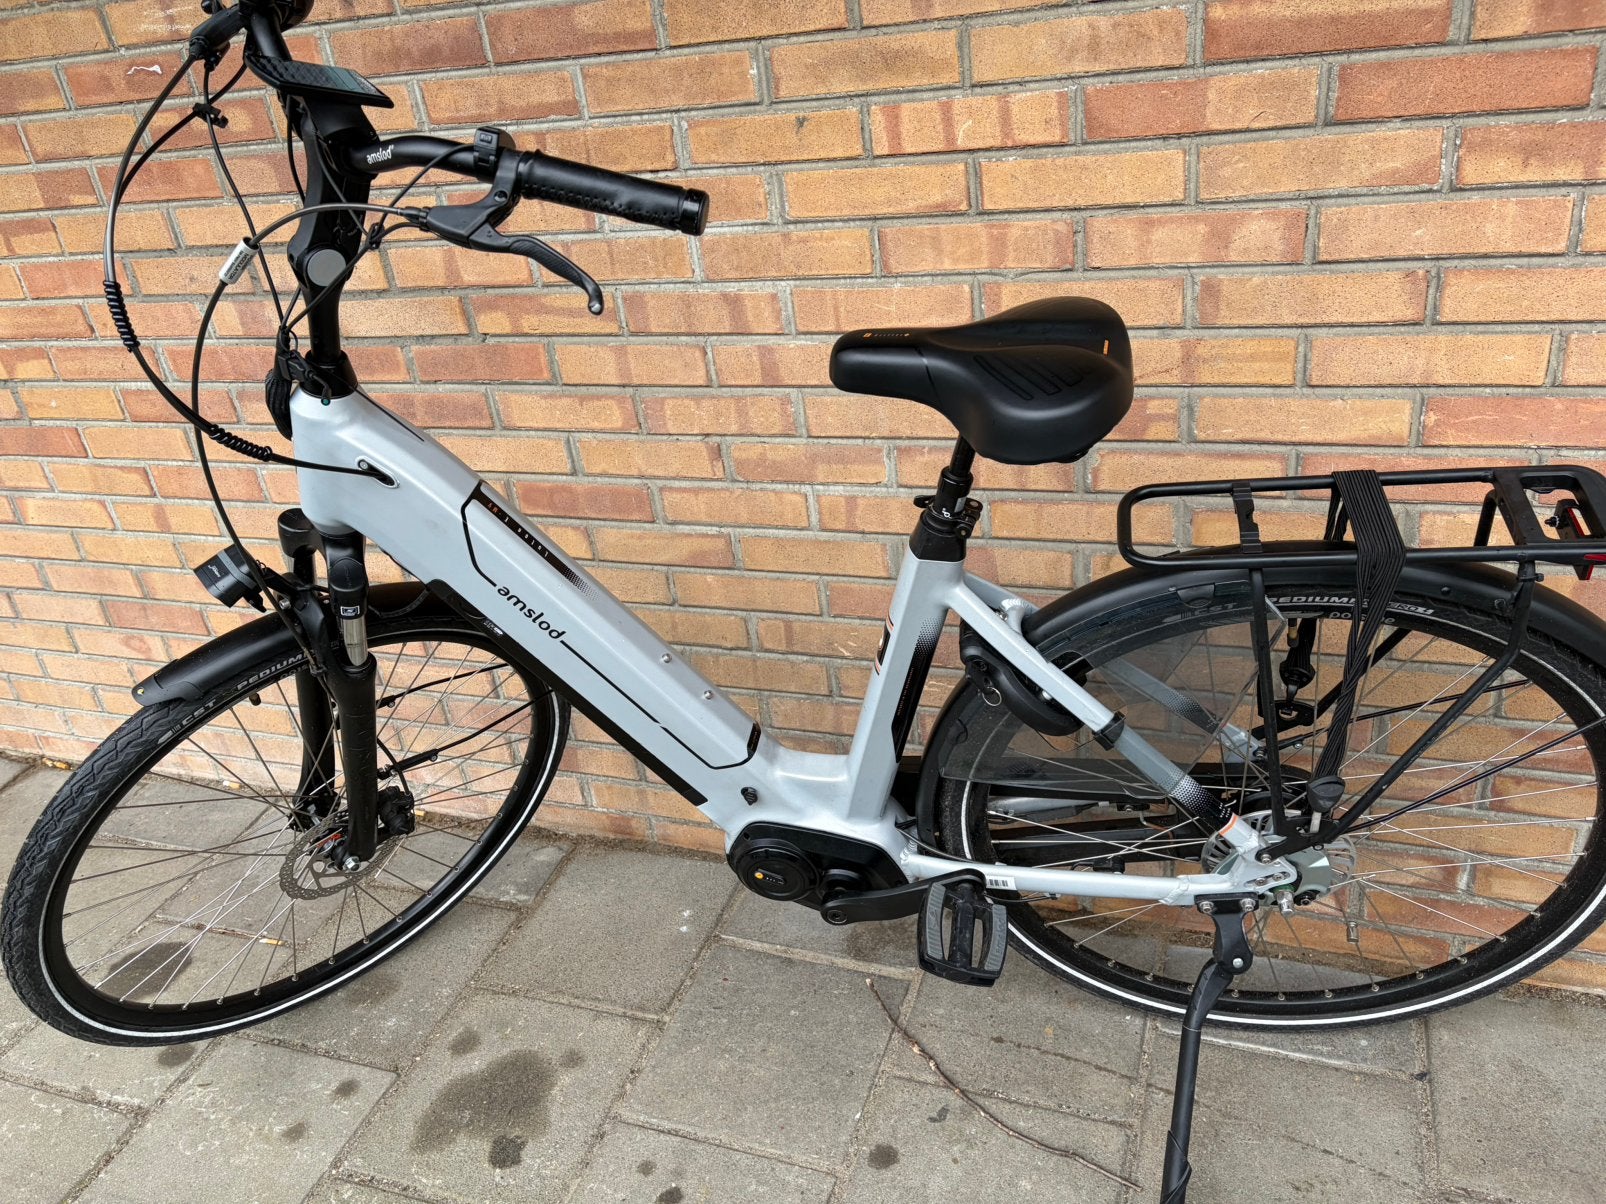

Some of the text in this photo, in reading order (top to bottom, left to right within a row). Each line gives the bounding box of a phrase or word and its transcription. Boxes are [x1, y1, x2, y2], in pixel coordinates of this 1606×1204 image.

[366, 145, 392, 164] amslod
[497, 586, 566, 640] amslod
[181, 699, 216, 726] CST
[236, 653, 303, 691] PEDIUM
